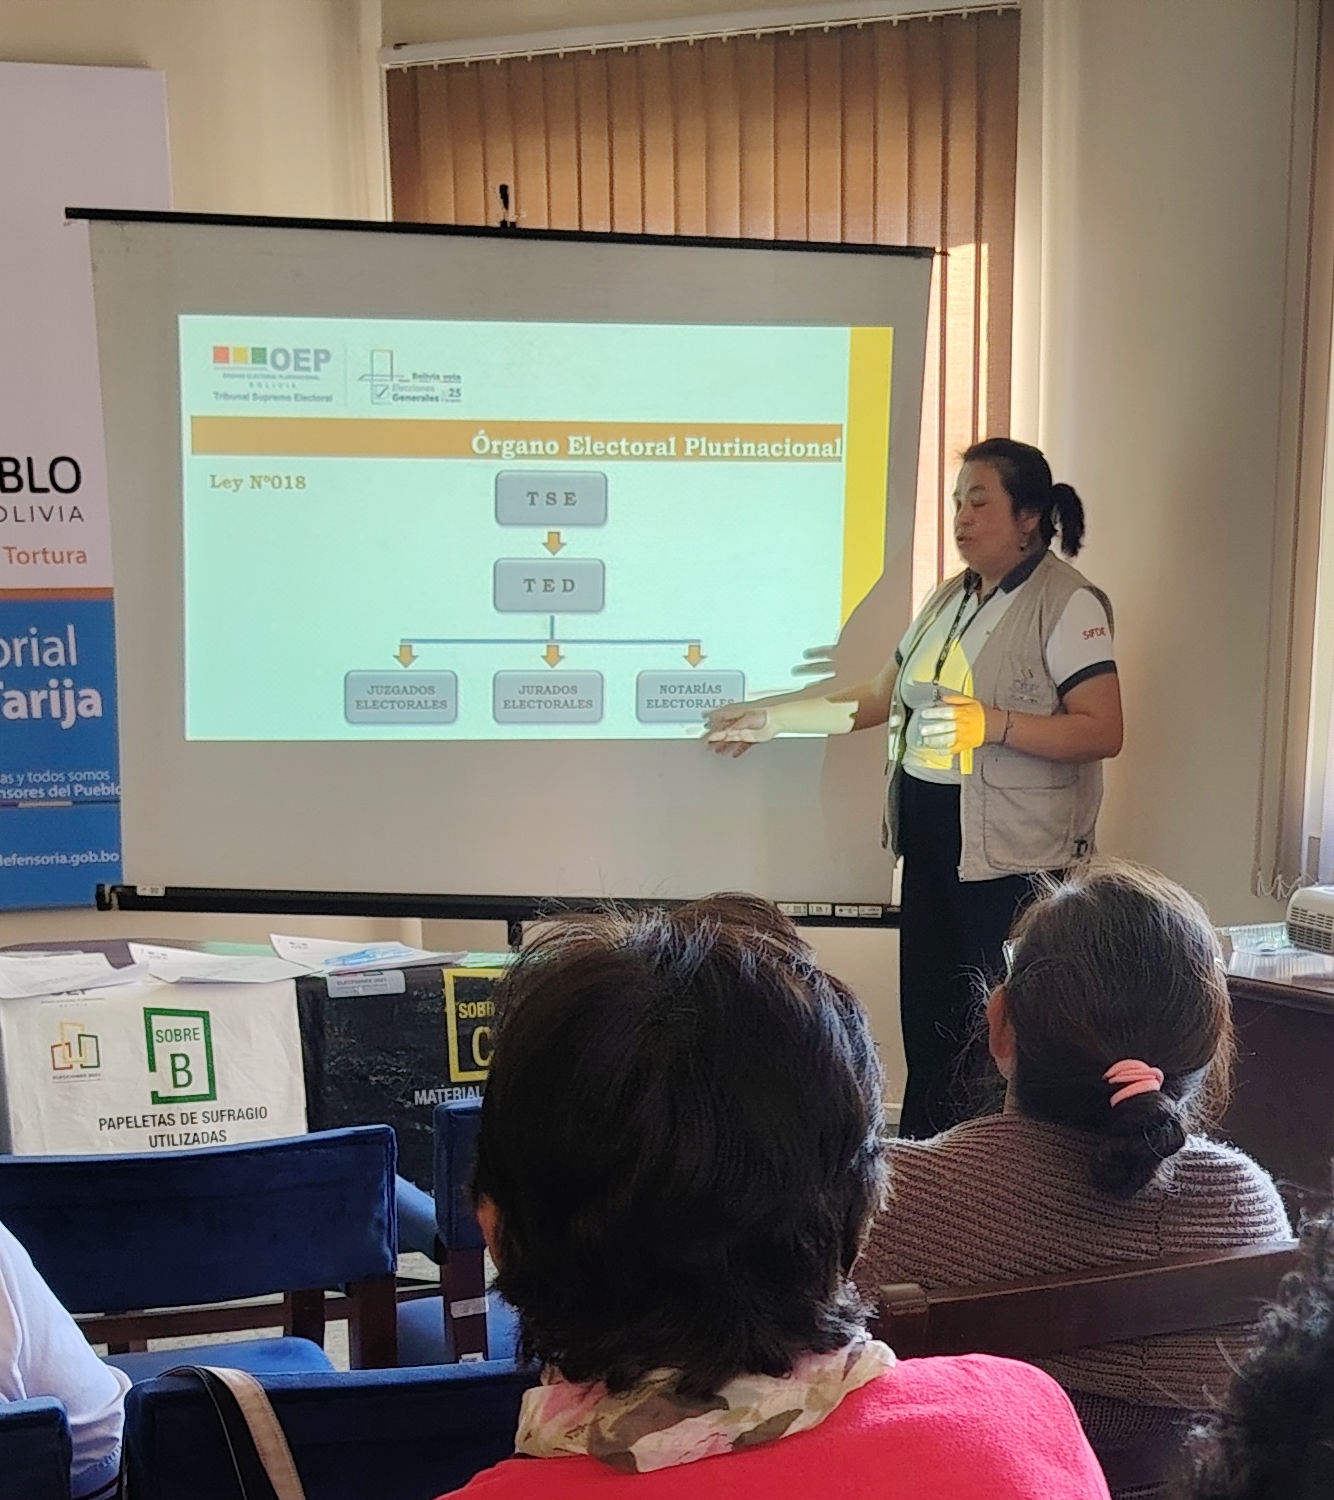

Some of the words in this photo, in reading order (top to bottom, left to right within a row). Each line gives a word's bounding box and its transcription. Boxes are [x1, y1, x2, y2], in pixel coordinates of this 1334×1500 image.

[270, 347, 331, 372] OEP
[213, 392, 250, 401] Tribunal
[252, 393, 292, 403] Supremo
[294, 393, 333, 402] Electoral
[471, 430, 560, 459] Órgano
[568, 436, 677, 457] Electoral
[684, 437, 842, 458] Plurinacional
[210, 475, 244, 492] Ley
[3, 546, 88, 565] Tortura
[367, 685, 435, 695] JUZGADOS
[518, 685, 578, 695] JURADOS
[659, 683, 722, 695] NOTARÍAS
[355, 700, 448, 710] ELECTORALES
[503, 700, 593, 709] ELECTORALES
[27, 769, 65, 783] todos
[68, 770, 110, 782] somos
[47, 784, 71, 799] del
[459, 1001, 495, 1018] SOBR
[155, 1028, 200, 1043] SOBRE
[170, 1053, 193, 1088] B
[99, 1112, 175, 1131] PAPELETAS
[181, 1111, 198, 1125] DE
[202, 1106, 268, 1124] SUFRAGIO
[149, 1130, 227, 1148] UTILIZADAS
